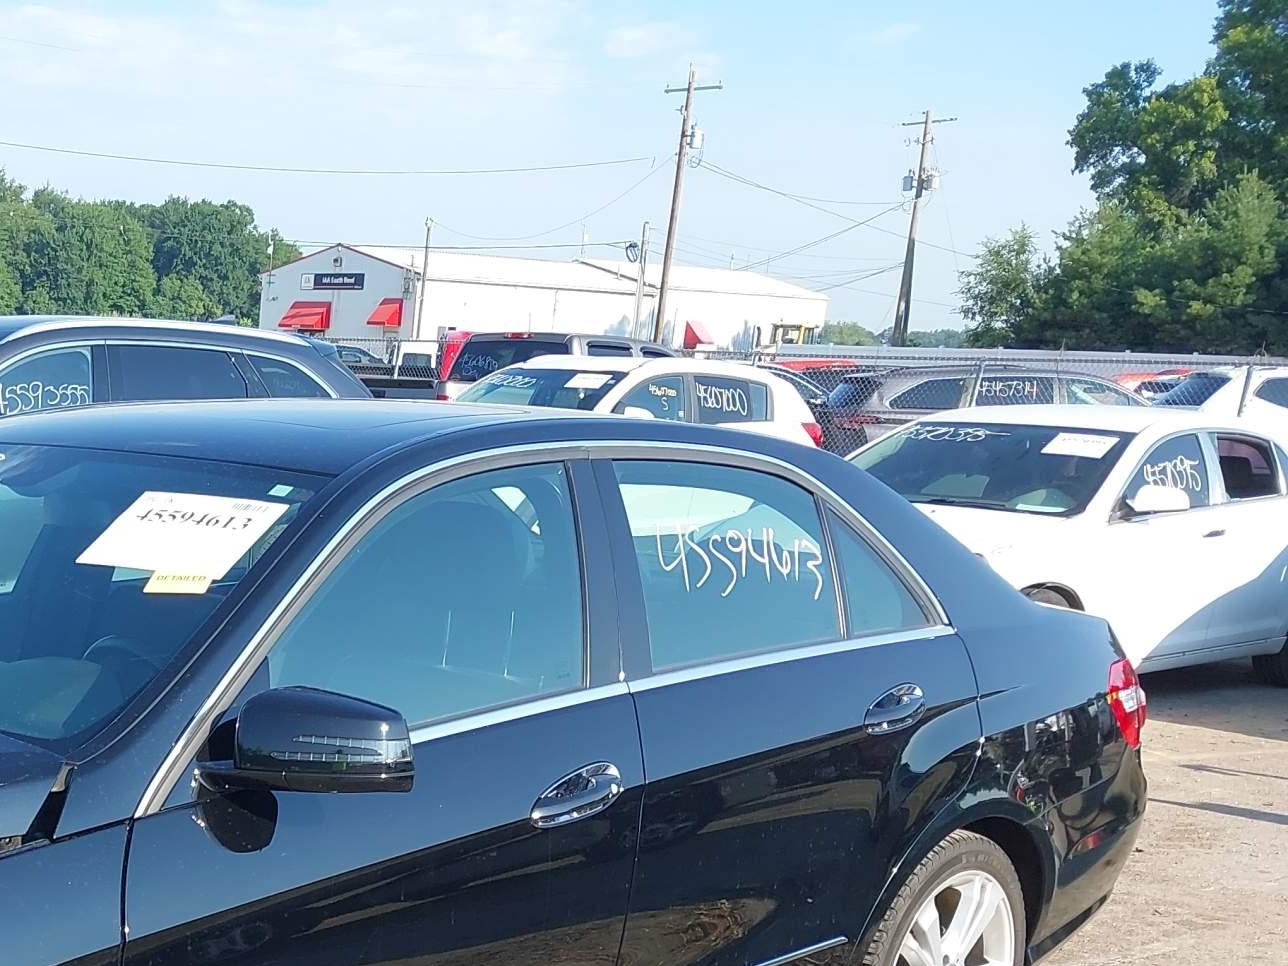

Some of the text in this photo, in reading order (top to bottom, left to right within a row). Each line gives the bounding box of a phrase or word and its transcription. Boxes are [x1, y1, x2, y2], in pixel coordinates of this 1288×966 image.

[661, 397, 669, 411] S
[695, 382, 748, 416] 45607000
[135, 507, 254, 531] 45594613
[656, 521, 823, 601] 45594613
